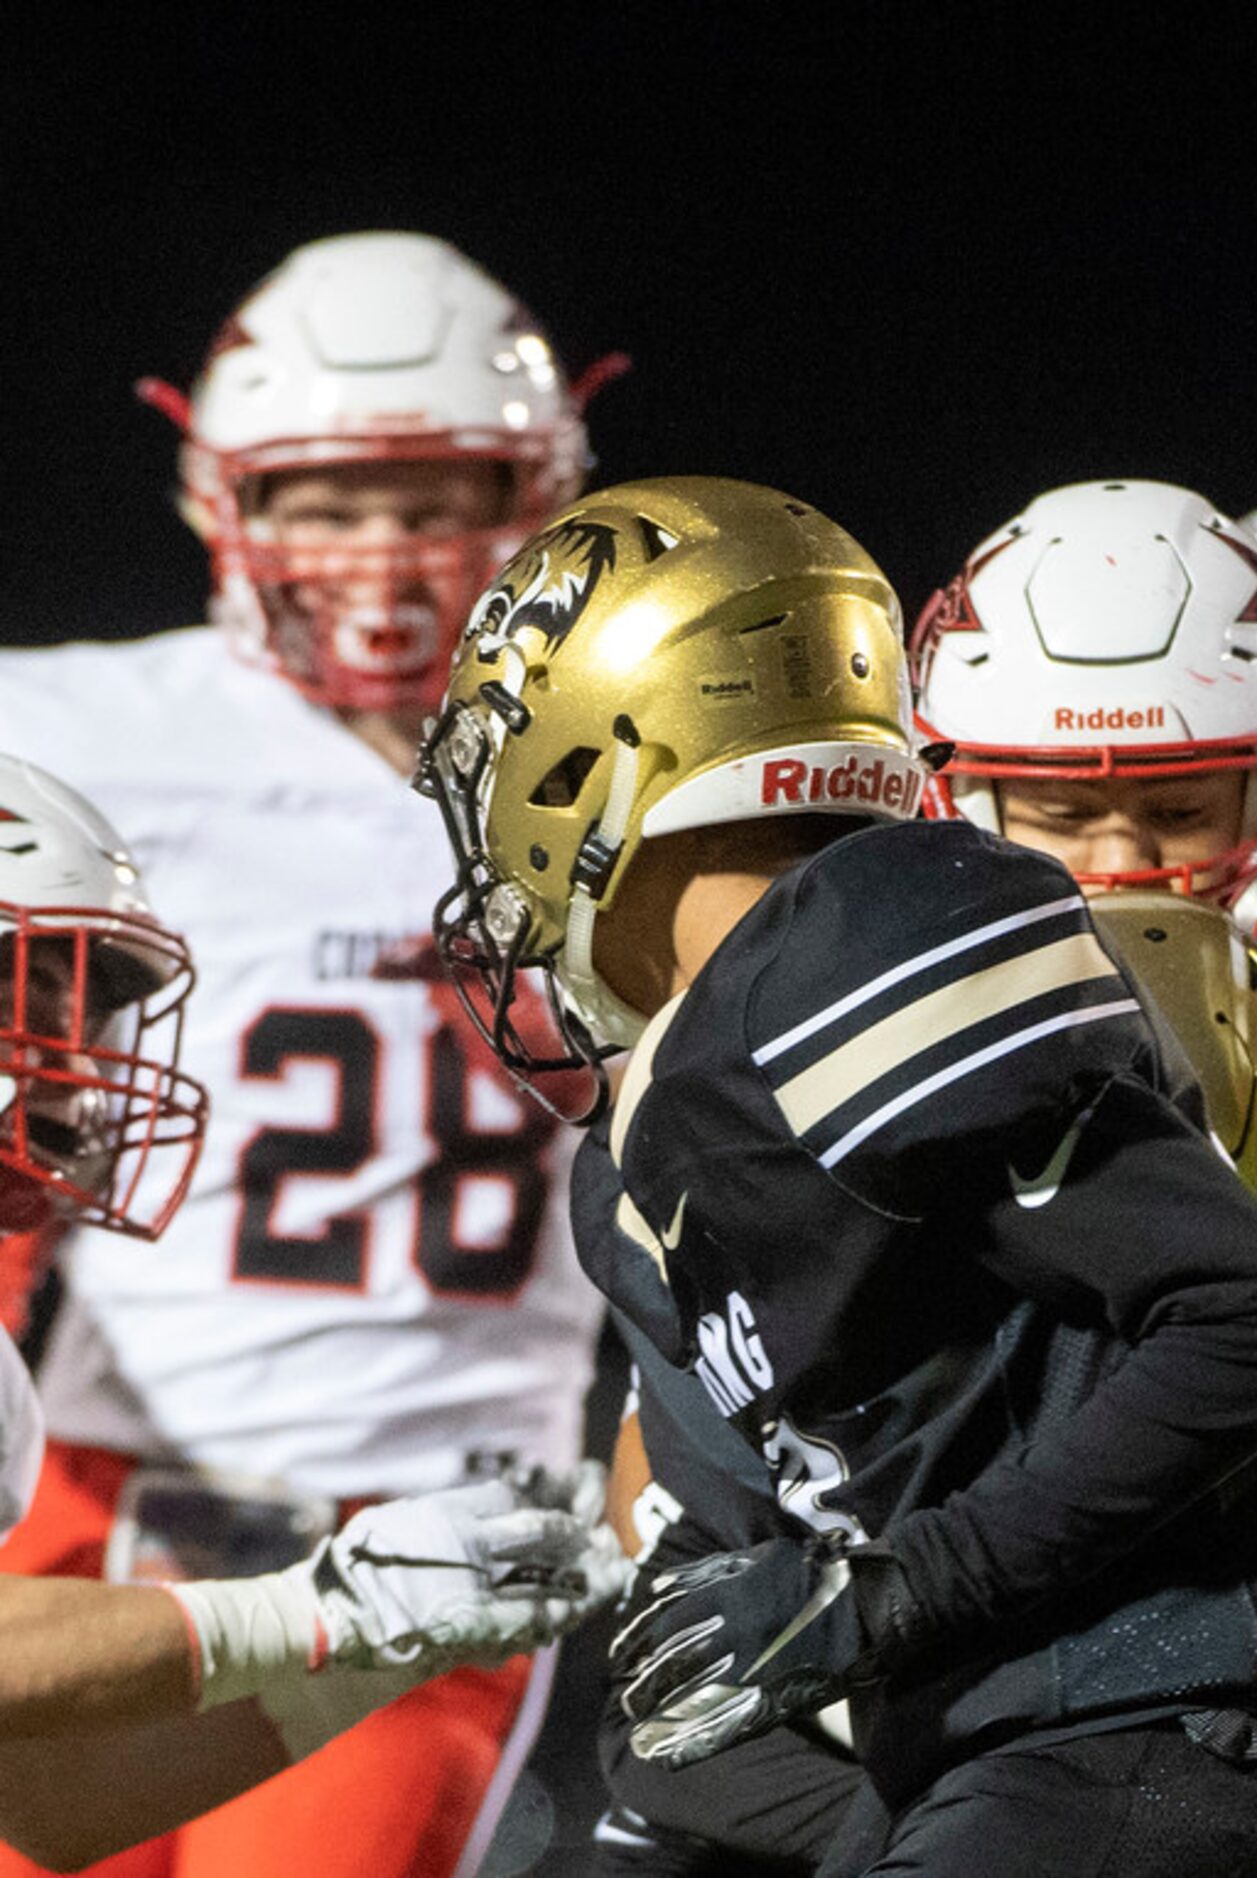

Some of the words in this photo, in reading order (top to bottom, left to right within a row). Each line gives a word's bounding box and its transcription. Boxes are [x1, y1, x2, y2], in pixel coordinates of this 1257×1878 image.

[1054, 706, 1165, 730] Riddell
[761, 755, 920, 814] Riddell
[231, 1005, 552, 1304] 28
